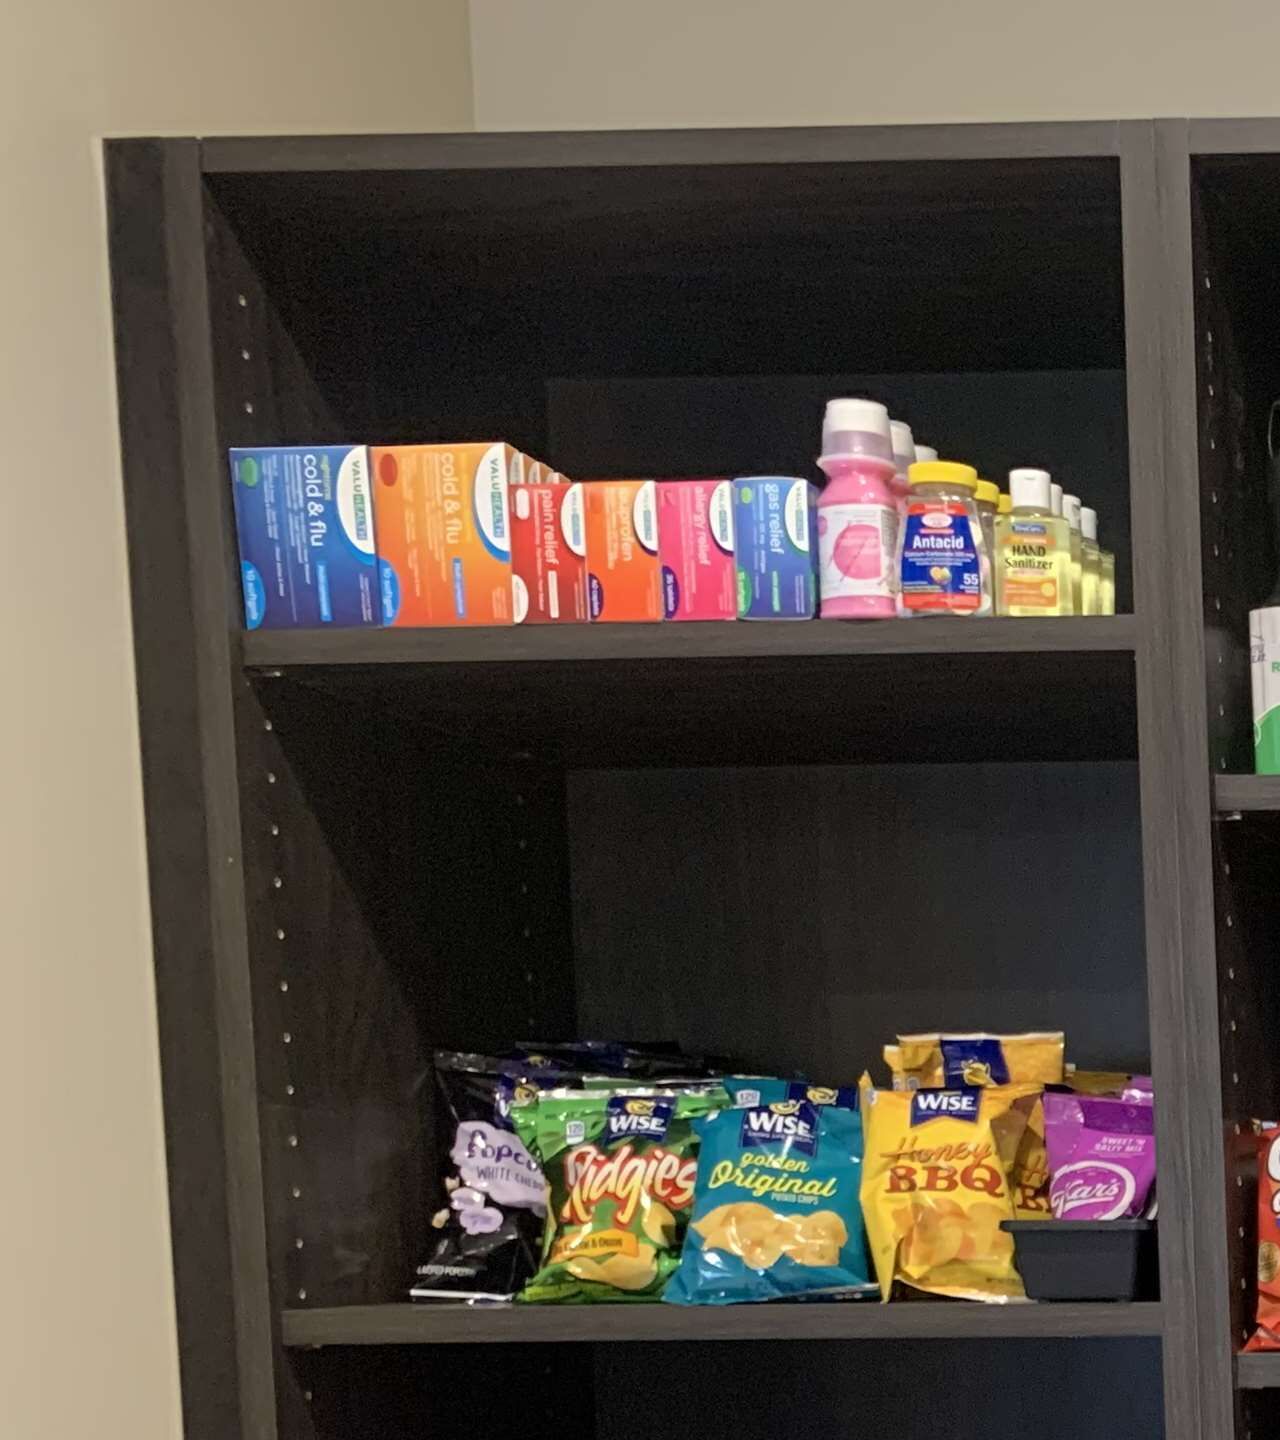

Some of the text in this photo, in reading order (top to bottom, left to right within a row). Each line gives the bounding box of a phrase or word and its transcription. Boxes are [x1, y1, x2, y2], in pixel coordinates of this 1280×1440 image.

[304, 454, 327, 547] cold & flu
[441, 453, 460, 545] cold & flu
[763, 484, 785, 555] gas relief
[912, 535, 965, 549] Antacid
[1012, 545, 1046, 557] HAND
[1004, 558, 1053, 570] Sanitizer
[963, 573, 979, 585] 55
[917, 1093, 977, 1112] WISE
[610, 1114, 667, 1133] WISE
[749, 1111, 811, 1135] WISE
[741, 1152, 810, 1173] golden
[880, 1136, 993, 1169] Honey
[565, 1144, 697, 1223] Ridgies
[708, 1160, 837, 1197] Original
[885, 1164, 1005, 1199] BBQ
